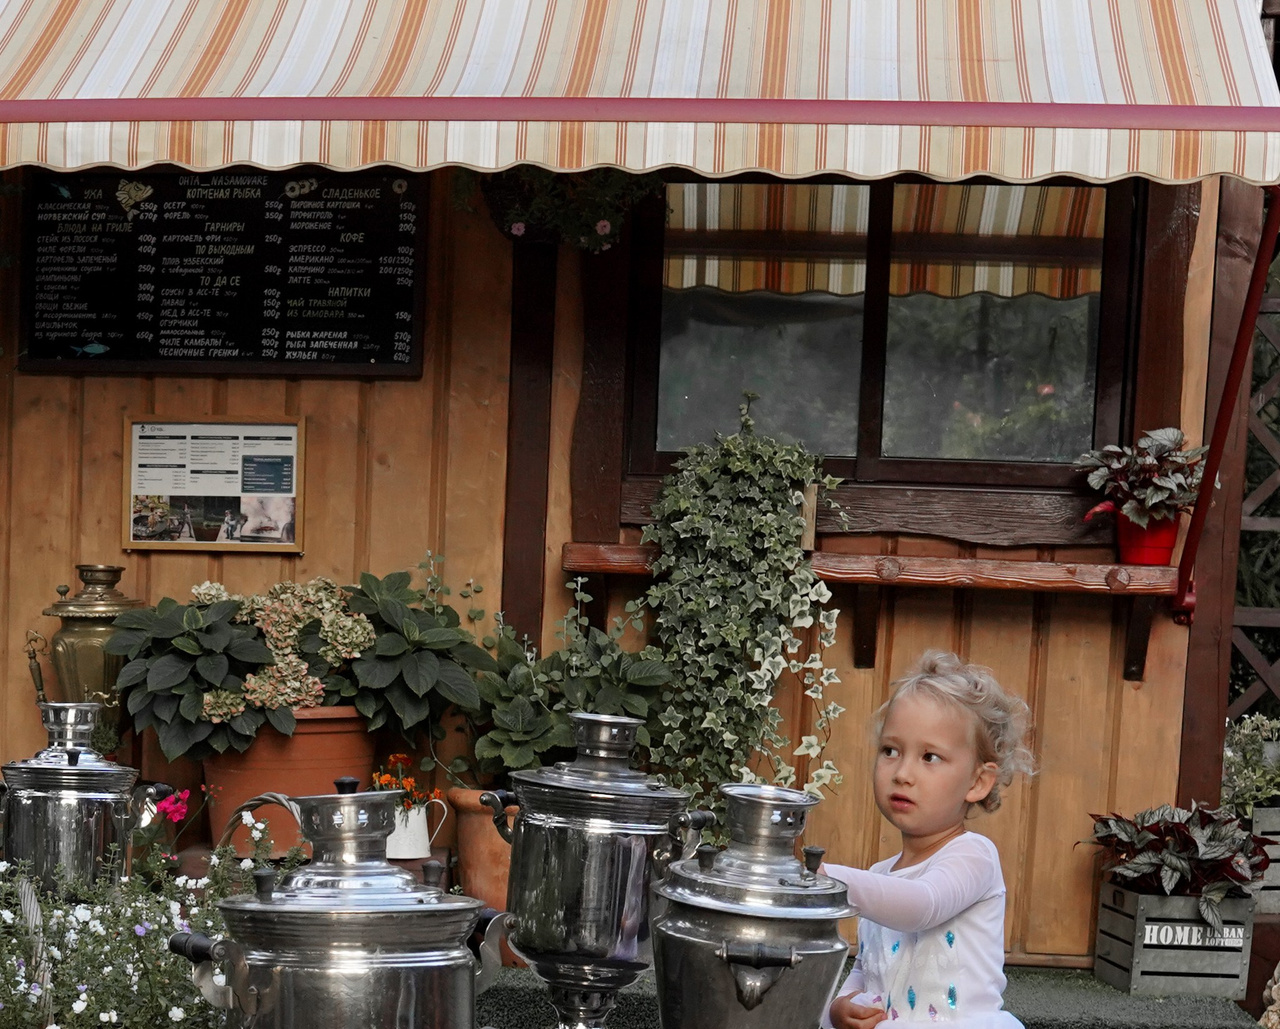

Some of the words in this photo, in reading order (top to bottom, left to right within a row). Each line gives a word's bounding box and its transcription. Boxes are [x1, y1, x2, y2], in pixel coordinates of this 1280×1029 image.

[83, 189, 103, 199] УХА
[186, 188, 231, 199] КОПЧЕНАЯ
[233, 188, 261, 198] РЫБКА
[322, 188, 381, 199] СЛАДЕНЬКОЕ
[37, 211, 88, 221] НОРВЕЖСКИЙ
[163, 212, 190, 220] ФОРЕЛЬ
[57, 223, 87, 233] БЛЮДА
[91, 223, 103, 232] НА
[106, 223, 133, 232] ГРИЛЕ
[204, 222, 245, 232] ГАРНИРЫ
[37, 233, 59, 243] СТЕЙК
[340, 233, 365, 243] КОФЕ
[195, 245, 206, 254] ПО
[208, 245, 255, 255] ВЫХОДНЫМ
[289, 245, 327, 253] ЭСПРЕССО
[162, 257, 180, 265] ПЛОВ
[183, 256, 224, 265] УЗБЕКСКИЙ
[289, 255, 334, 263] АМЕРИКАНО
[288, 266, 325, 274] КАПУЧИНО
[200, 276, 211, 286] ТО
[214, 276, 227, 286] ДА
[230, 276, 241, 286] СЕ
[288, 276, 311, 284] ЛАТТЕ
[328, 287, 371, 297] НАПИТКИ
[35, 293, 59, 301] ОВОЩИ
[35, 303, 59, 311] ОВОЩИ
[286, 298, 304, 307] ЧАЙ
[309, 298, 347, 307] ТРАВЯНОЙ
[160, 309, 178, 317] МЕД
[181, 309, 185, 317] В
[286, 309, 298, 317] ИЗ
[302, 310, 345, 318] САМОВАРА
[286, 331, 311, 339] РЫБКА
[312, 331, 348, 339] ЖАРЕНАЯ
[159, 338, 181, 346] ФИЛЕ
[184, 338, 222, 346] КАМБАЛЫ
[286, 341, 306, 349] РЫБА
[310, 341, 359, 349] ЗАПЕЧЕННАЯ
[208, 349, 239, 357] ГРЕНКИ
[1144, 925, 1203, 945] HOME
